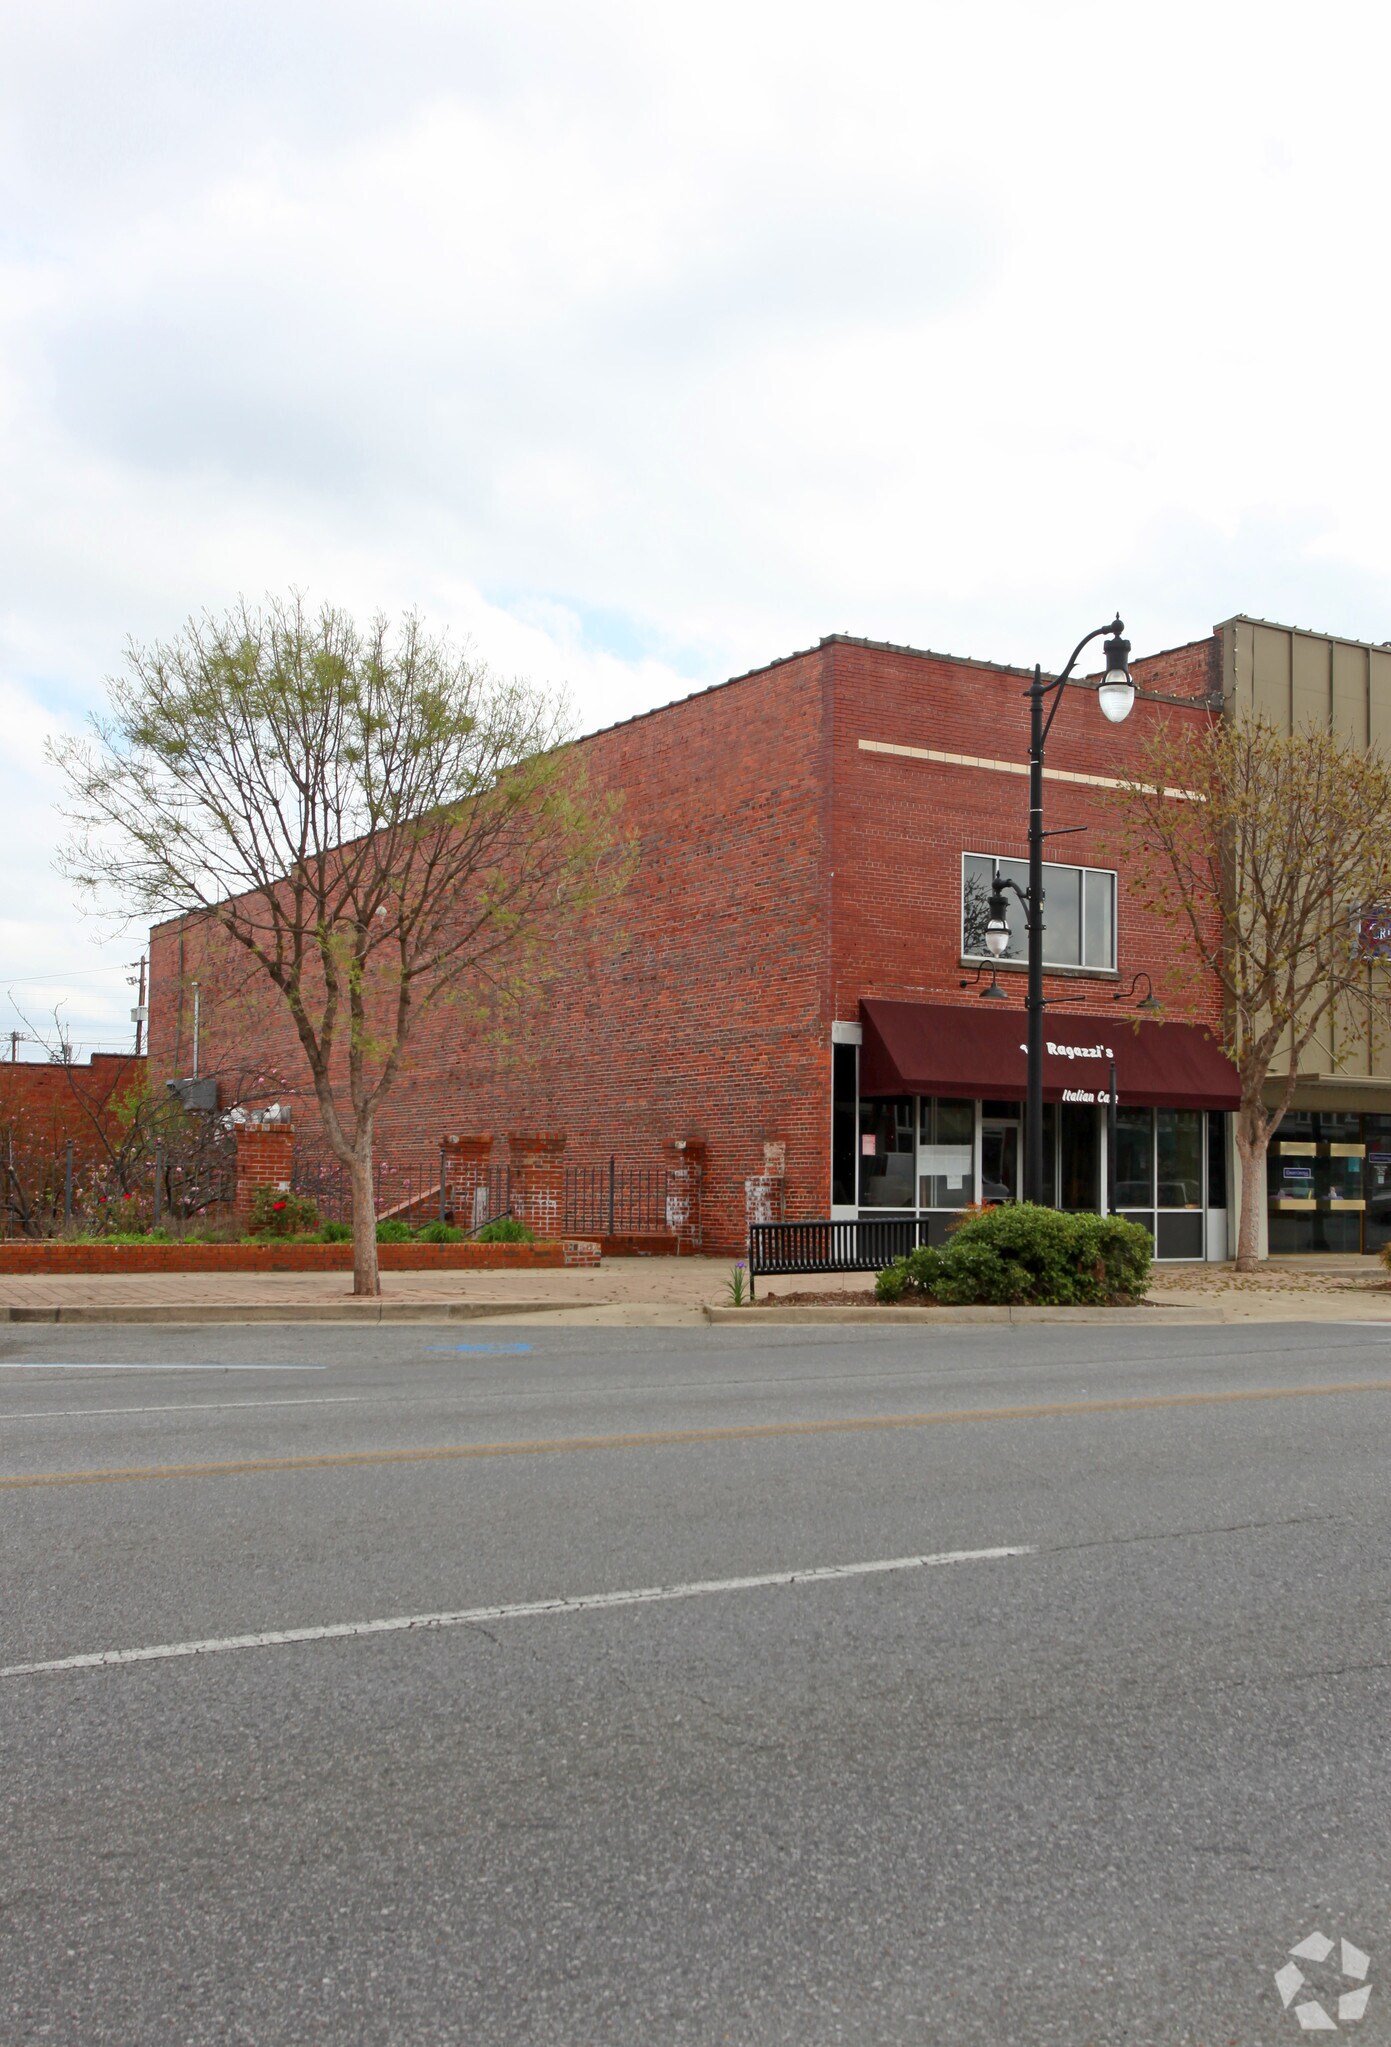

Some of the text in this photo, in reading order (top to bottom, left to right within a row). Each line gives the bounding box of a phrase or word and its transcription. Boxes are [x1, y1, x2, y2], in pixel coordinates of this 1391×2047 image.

[1046, 1042, 1114, 1059] Ragazzi's
[1062, 1089, 1119, 1104] Italian Cae
